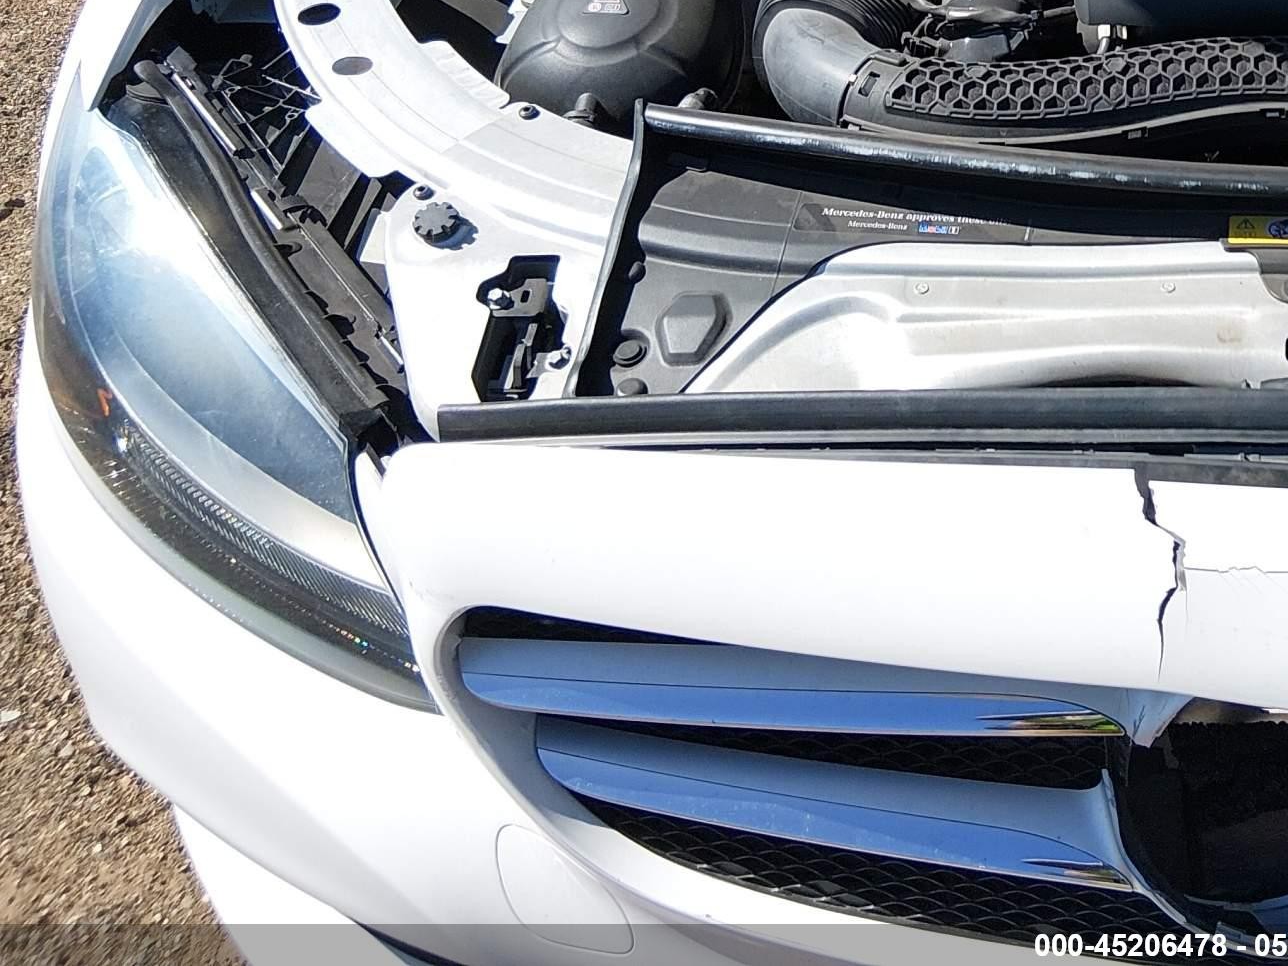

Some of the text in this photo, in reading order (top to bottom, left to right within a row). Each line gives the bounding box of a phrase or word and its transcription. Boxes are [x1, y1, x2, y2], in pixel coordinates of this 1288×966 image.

[821, 208, 904, 220] Mercedes-Benz
[905, 212, 955, 222] approves
[847, 220, 908, 230] Mercedes-Benz
